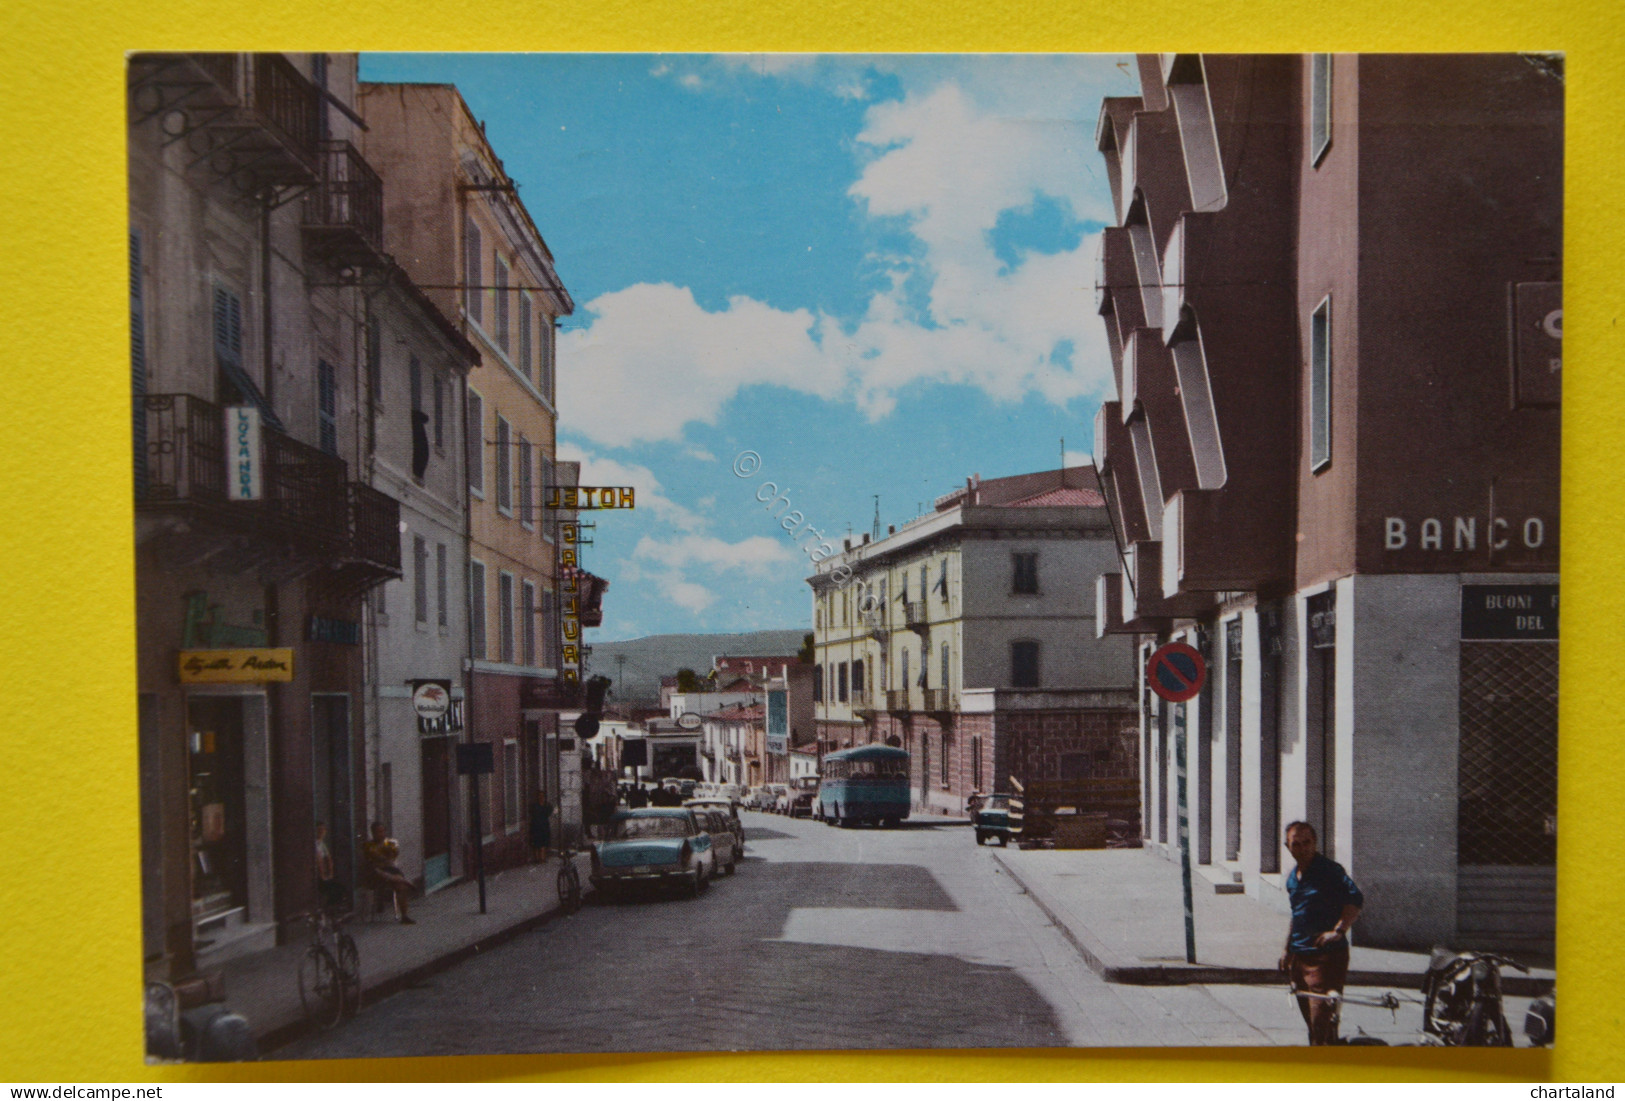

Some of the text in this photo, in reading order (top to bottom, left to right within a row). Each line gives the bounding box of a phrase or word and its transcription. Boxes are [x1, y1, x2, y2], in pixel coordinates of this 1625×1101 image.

[238, 407, 251, 499] LOCANDA
[1385, 517, 1544, 550] BANCO
[1485, 595, 1532, 609] BUONI
[1515, 616, 1545, 630] DEL
